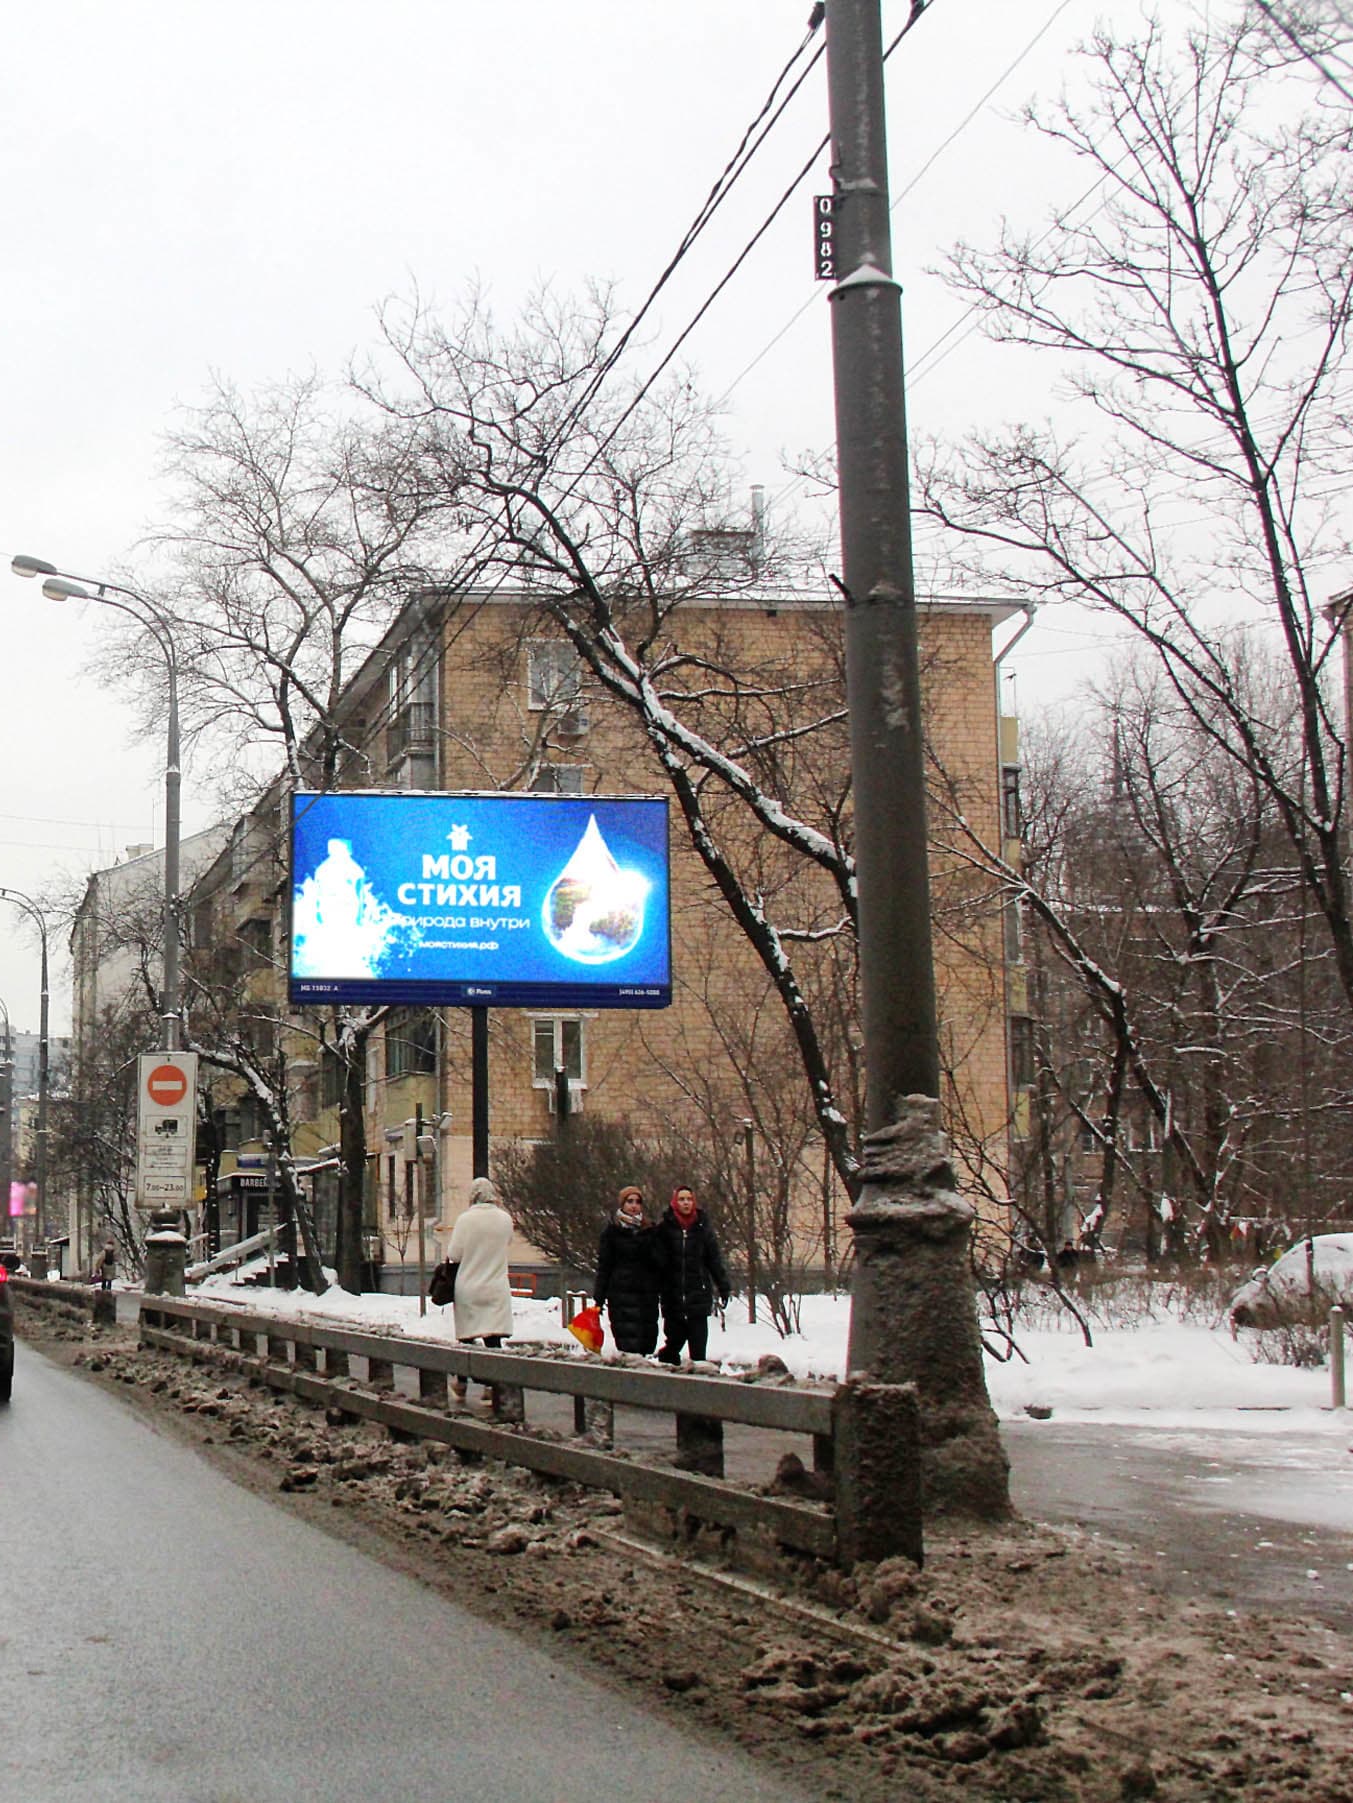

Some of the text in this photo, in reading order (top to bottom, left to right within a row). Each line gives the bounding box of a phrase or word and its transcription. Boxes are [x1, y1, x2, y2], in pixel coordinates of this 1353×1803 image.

[819, 198, 833, 276] 0982
[422, 854, 496, 881] МОЯ
[397, 883, 522, 908] СТИХИЯ
[470, 917, 531, 931] внутри
